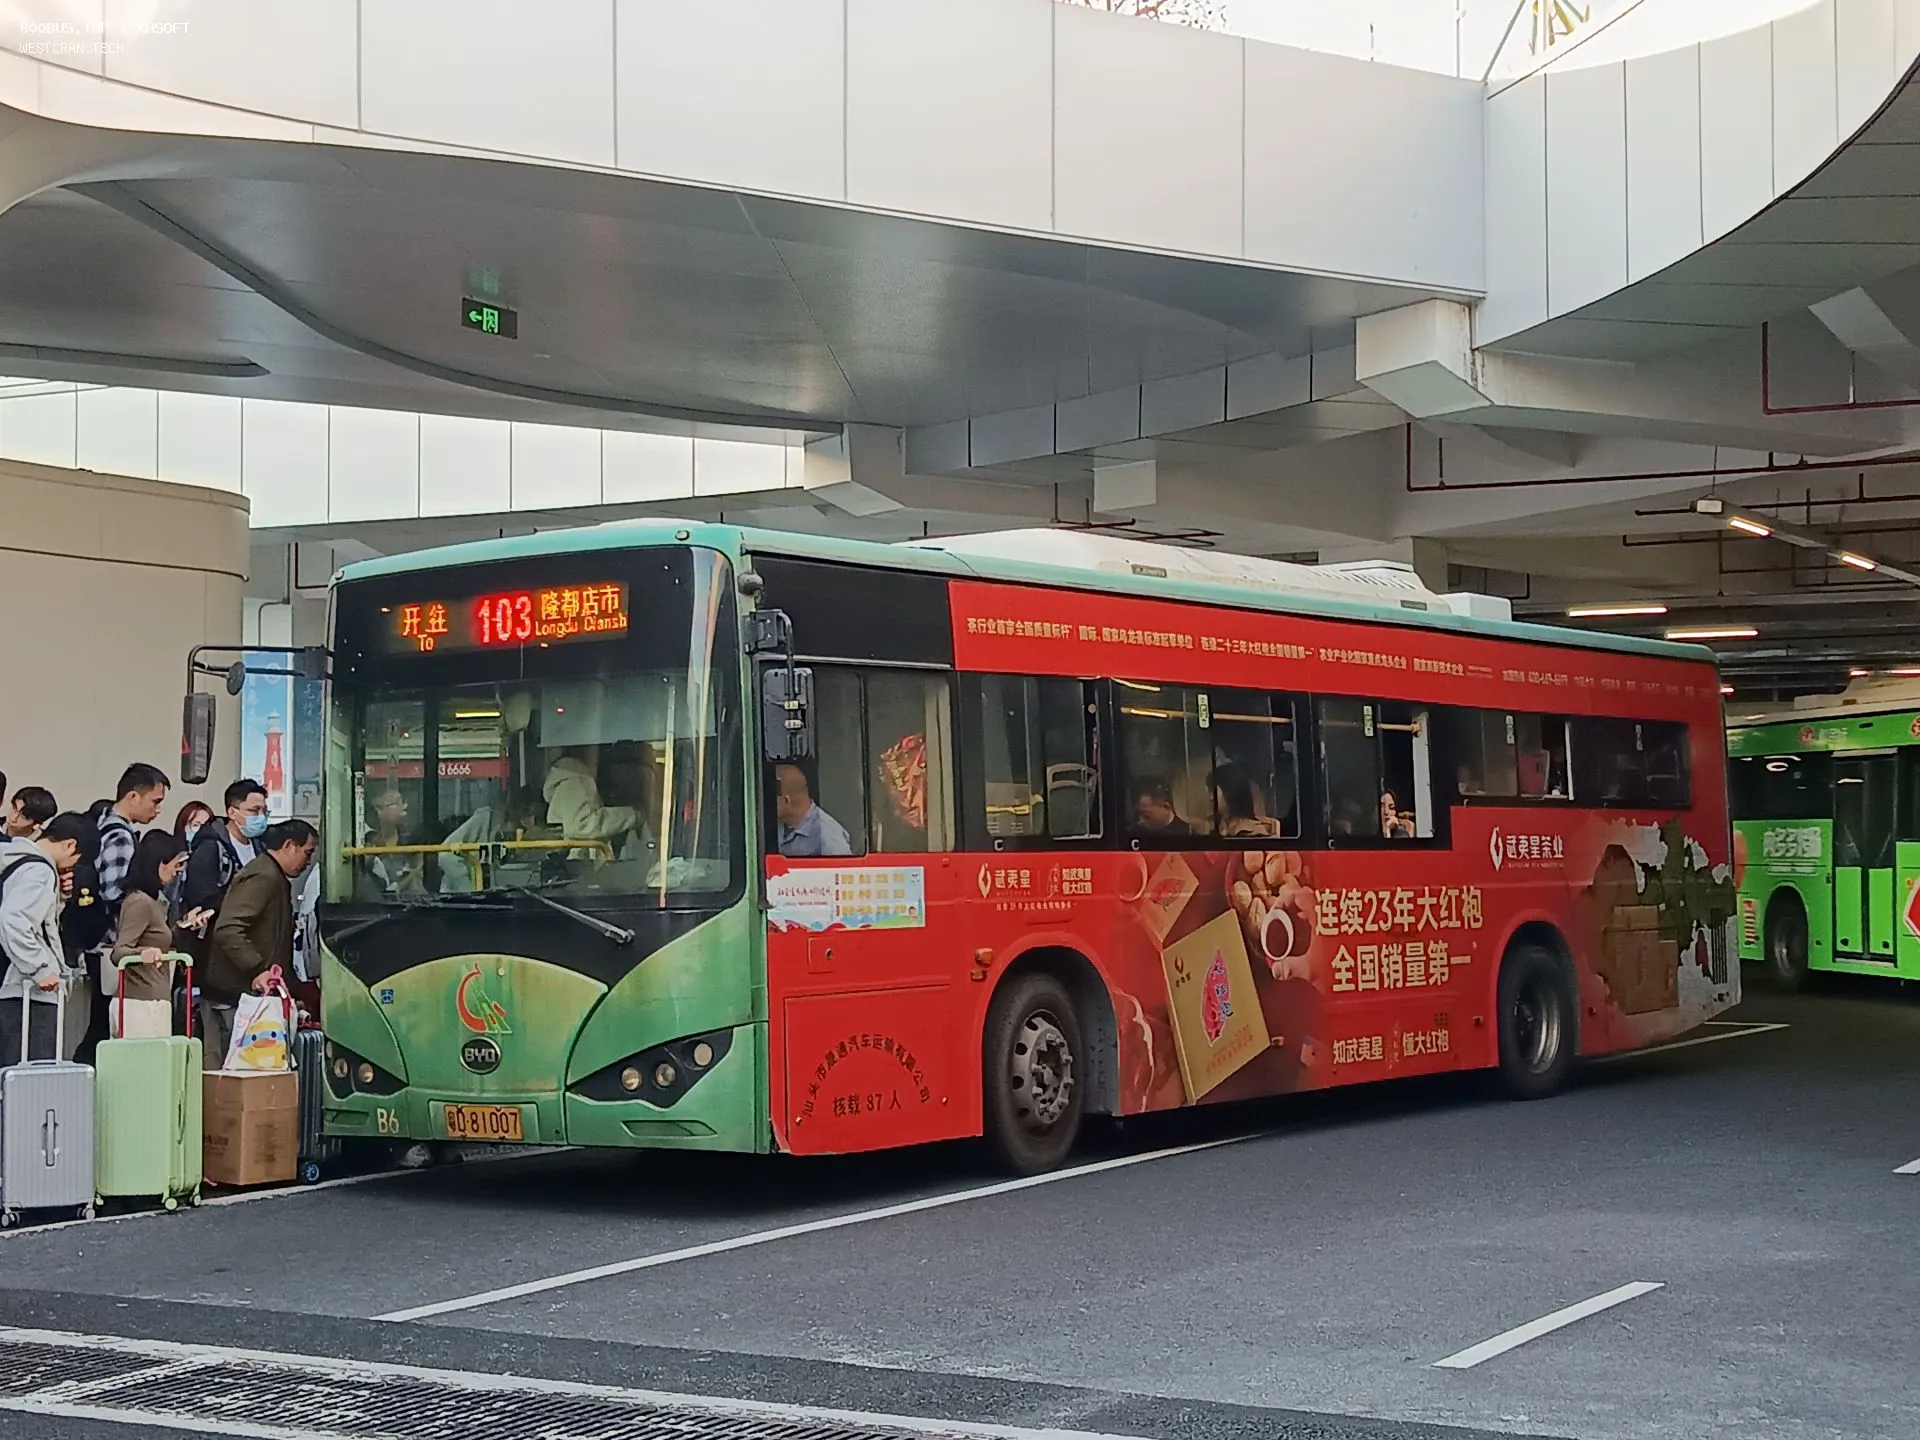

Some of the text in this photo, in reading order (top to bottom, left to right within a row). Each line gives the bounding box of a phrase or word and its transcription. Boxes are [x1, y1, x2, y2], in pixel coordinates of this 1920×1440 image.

[541, 585, 620, 620] 隆都店市
[402, 604, 448, 636] 开往
[478, 596, 532, 643] 103
[417, 634, 434, 651] To
[1315, 885, 1484, 936] 连续23年大红袍
[1331, 940, 1472, 992] 全国销量第一
[464, 1048, 496, 1063] BYD
[1333, 1035, 1383, 1064] 知武夷星
[866, 1093, 882, 1111] 87
[890, 1090, 901, 1110] 人
[377, 1107, 399, 1134] B6
